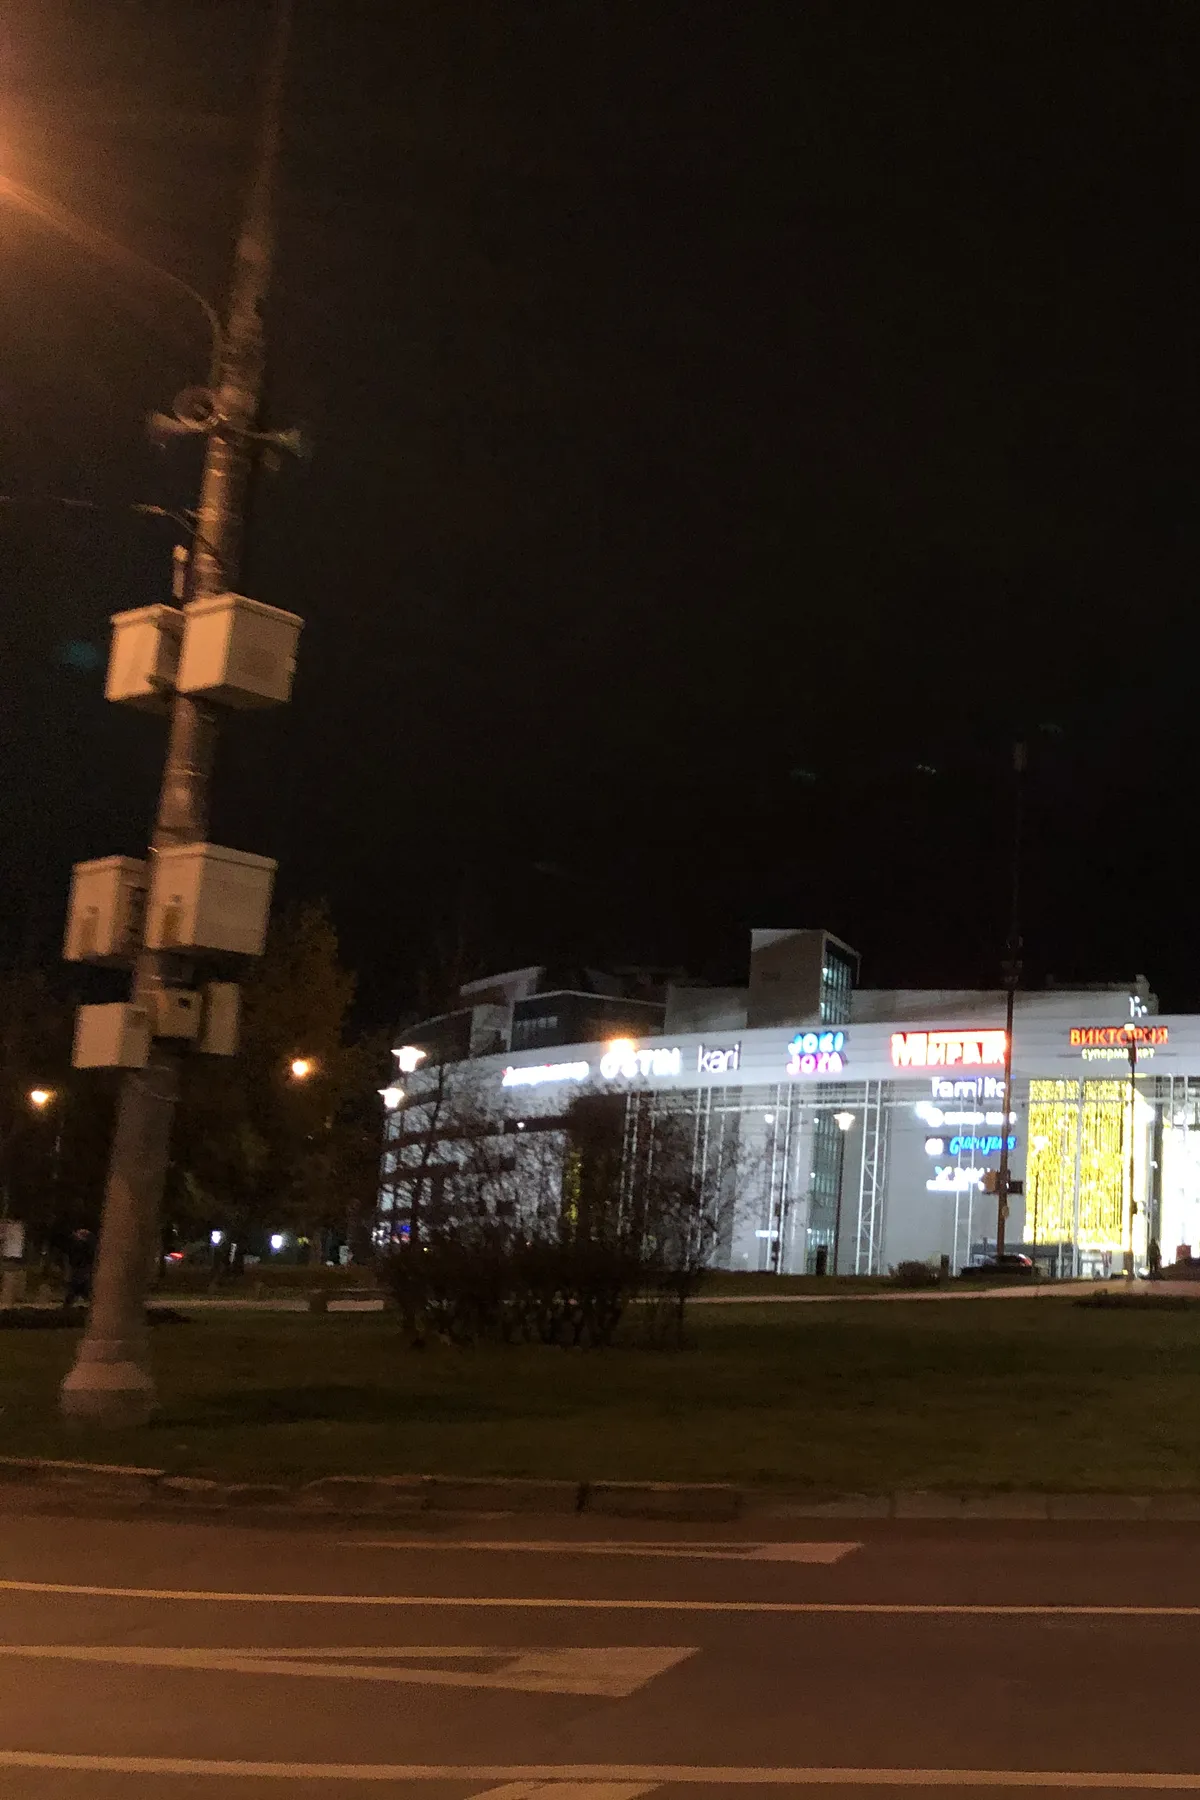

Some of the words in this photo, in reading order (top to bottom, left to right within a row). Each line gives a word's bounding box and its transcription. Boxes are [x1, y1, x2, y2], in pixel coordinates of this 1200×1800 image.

[787, 1032, 845, 1054] JOKI
[1069, 1025, 1169, 1046] ВИКТОРИЯ
[697, 1041, 741, 1073] kari
[1081, 1047, 1155, 1062] супермакет
